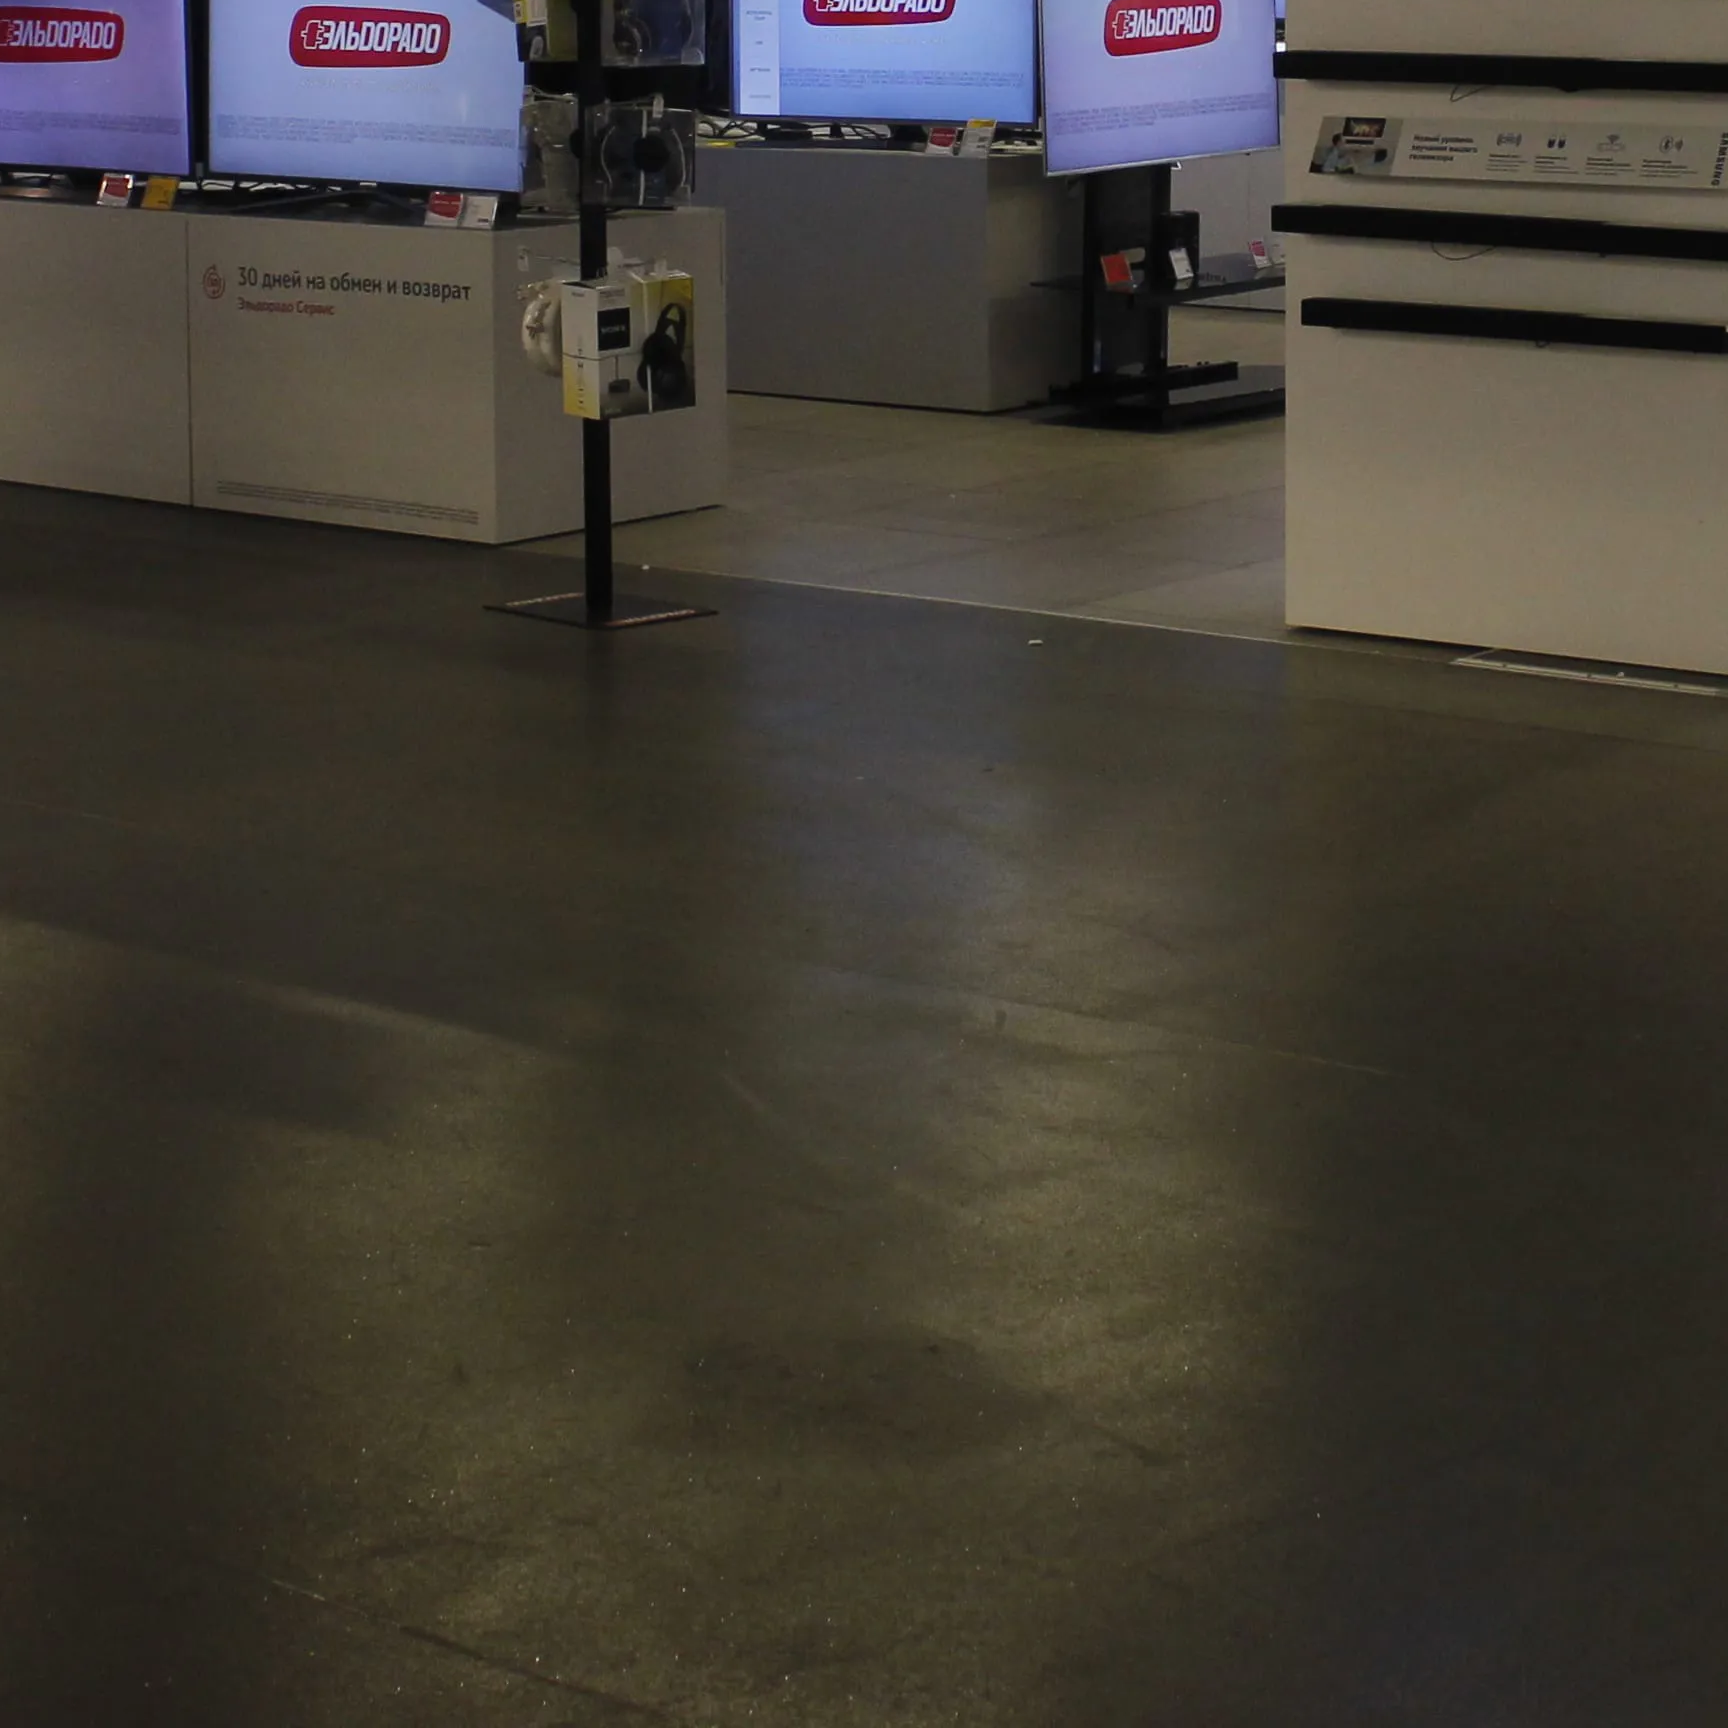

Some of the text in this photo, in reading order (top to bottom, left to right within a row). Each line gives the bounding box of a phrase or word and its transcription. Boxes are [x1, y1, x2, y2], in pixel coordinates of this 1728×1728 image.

[238, 266, 472, 304] 30 дней на обмен и возврат
